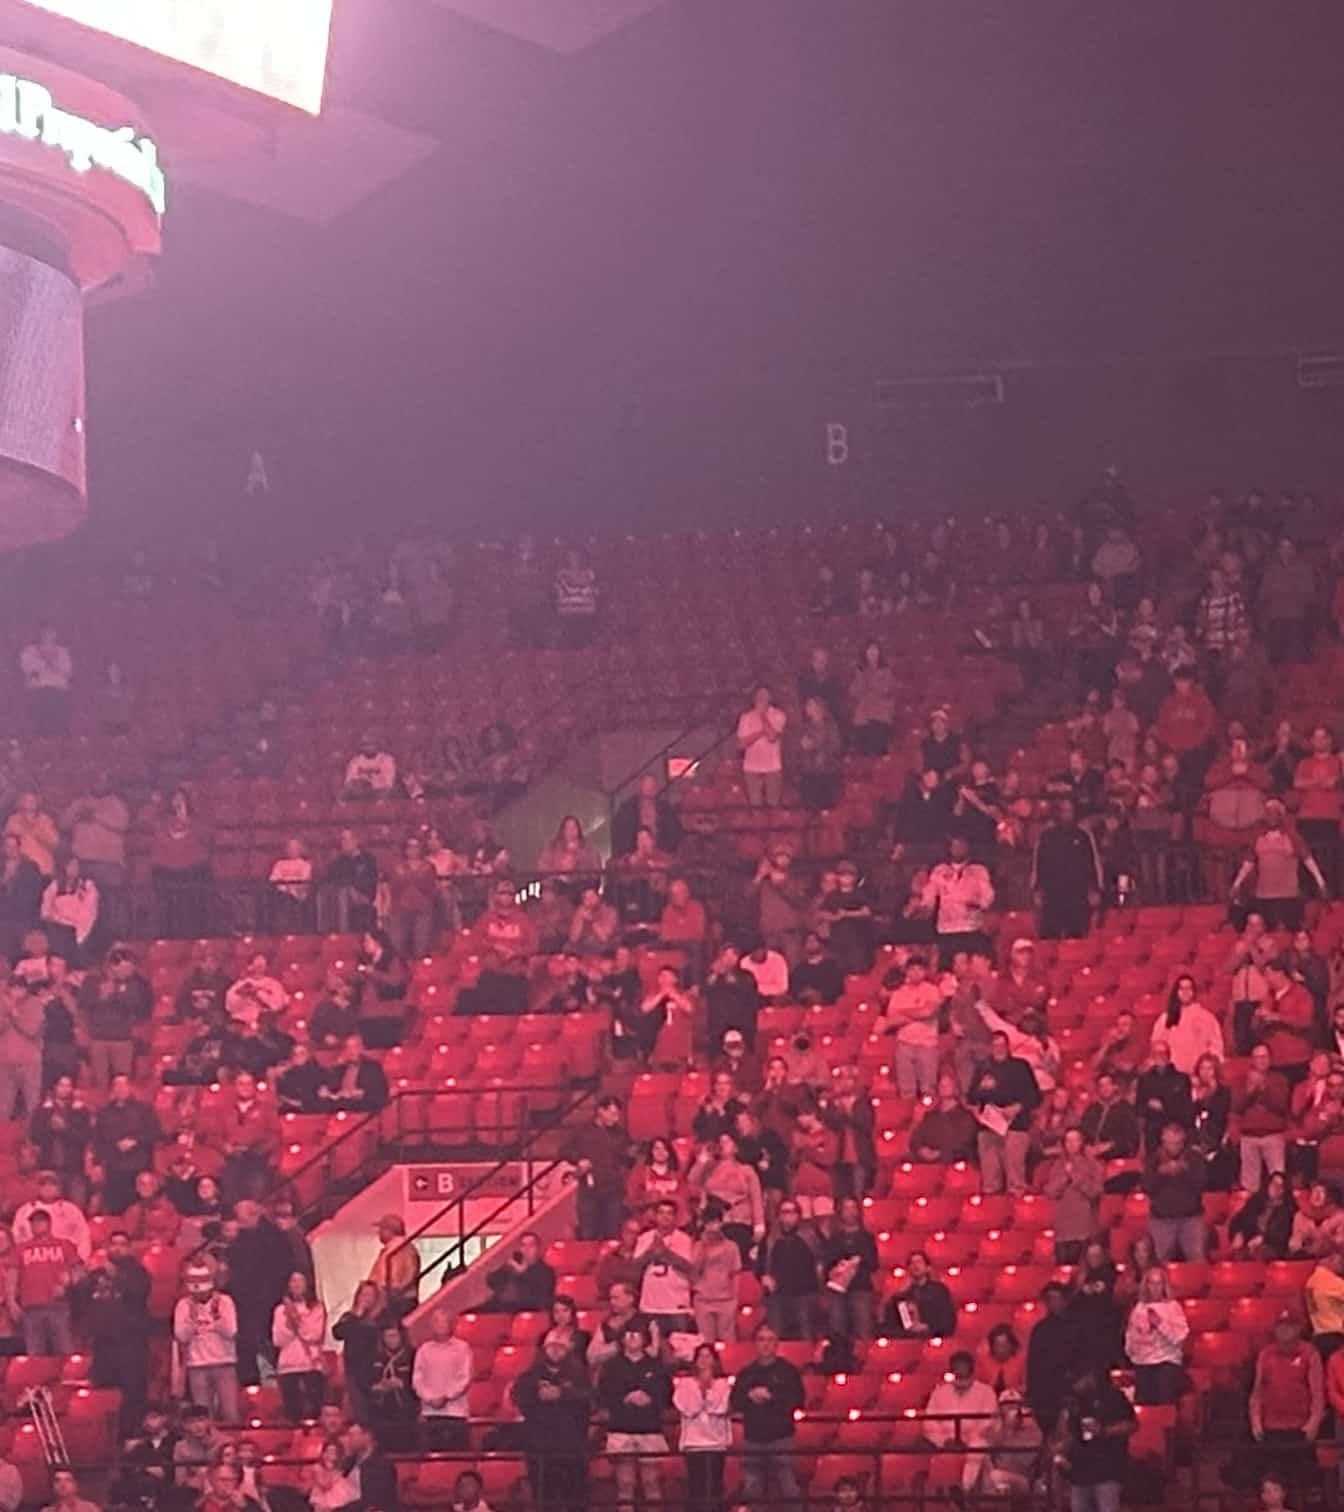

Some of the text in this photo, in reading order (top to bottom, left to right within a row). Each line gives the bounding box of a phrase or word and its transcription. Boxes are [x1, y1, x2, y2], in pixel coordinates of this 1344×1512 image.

[827, 423, 849, 463] B
[243, 451, 271, 496] A
[437, 1173, 453, 1192] B
